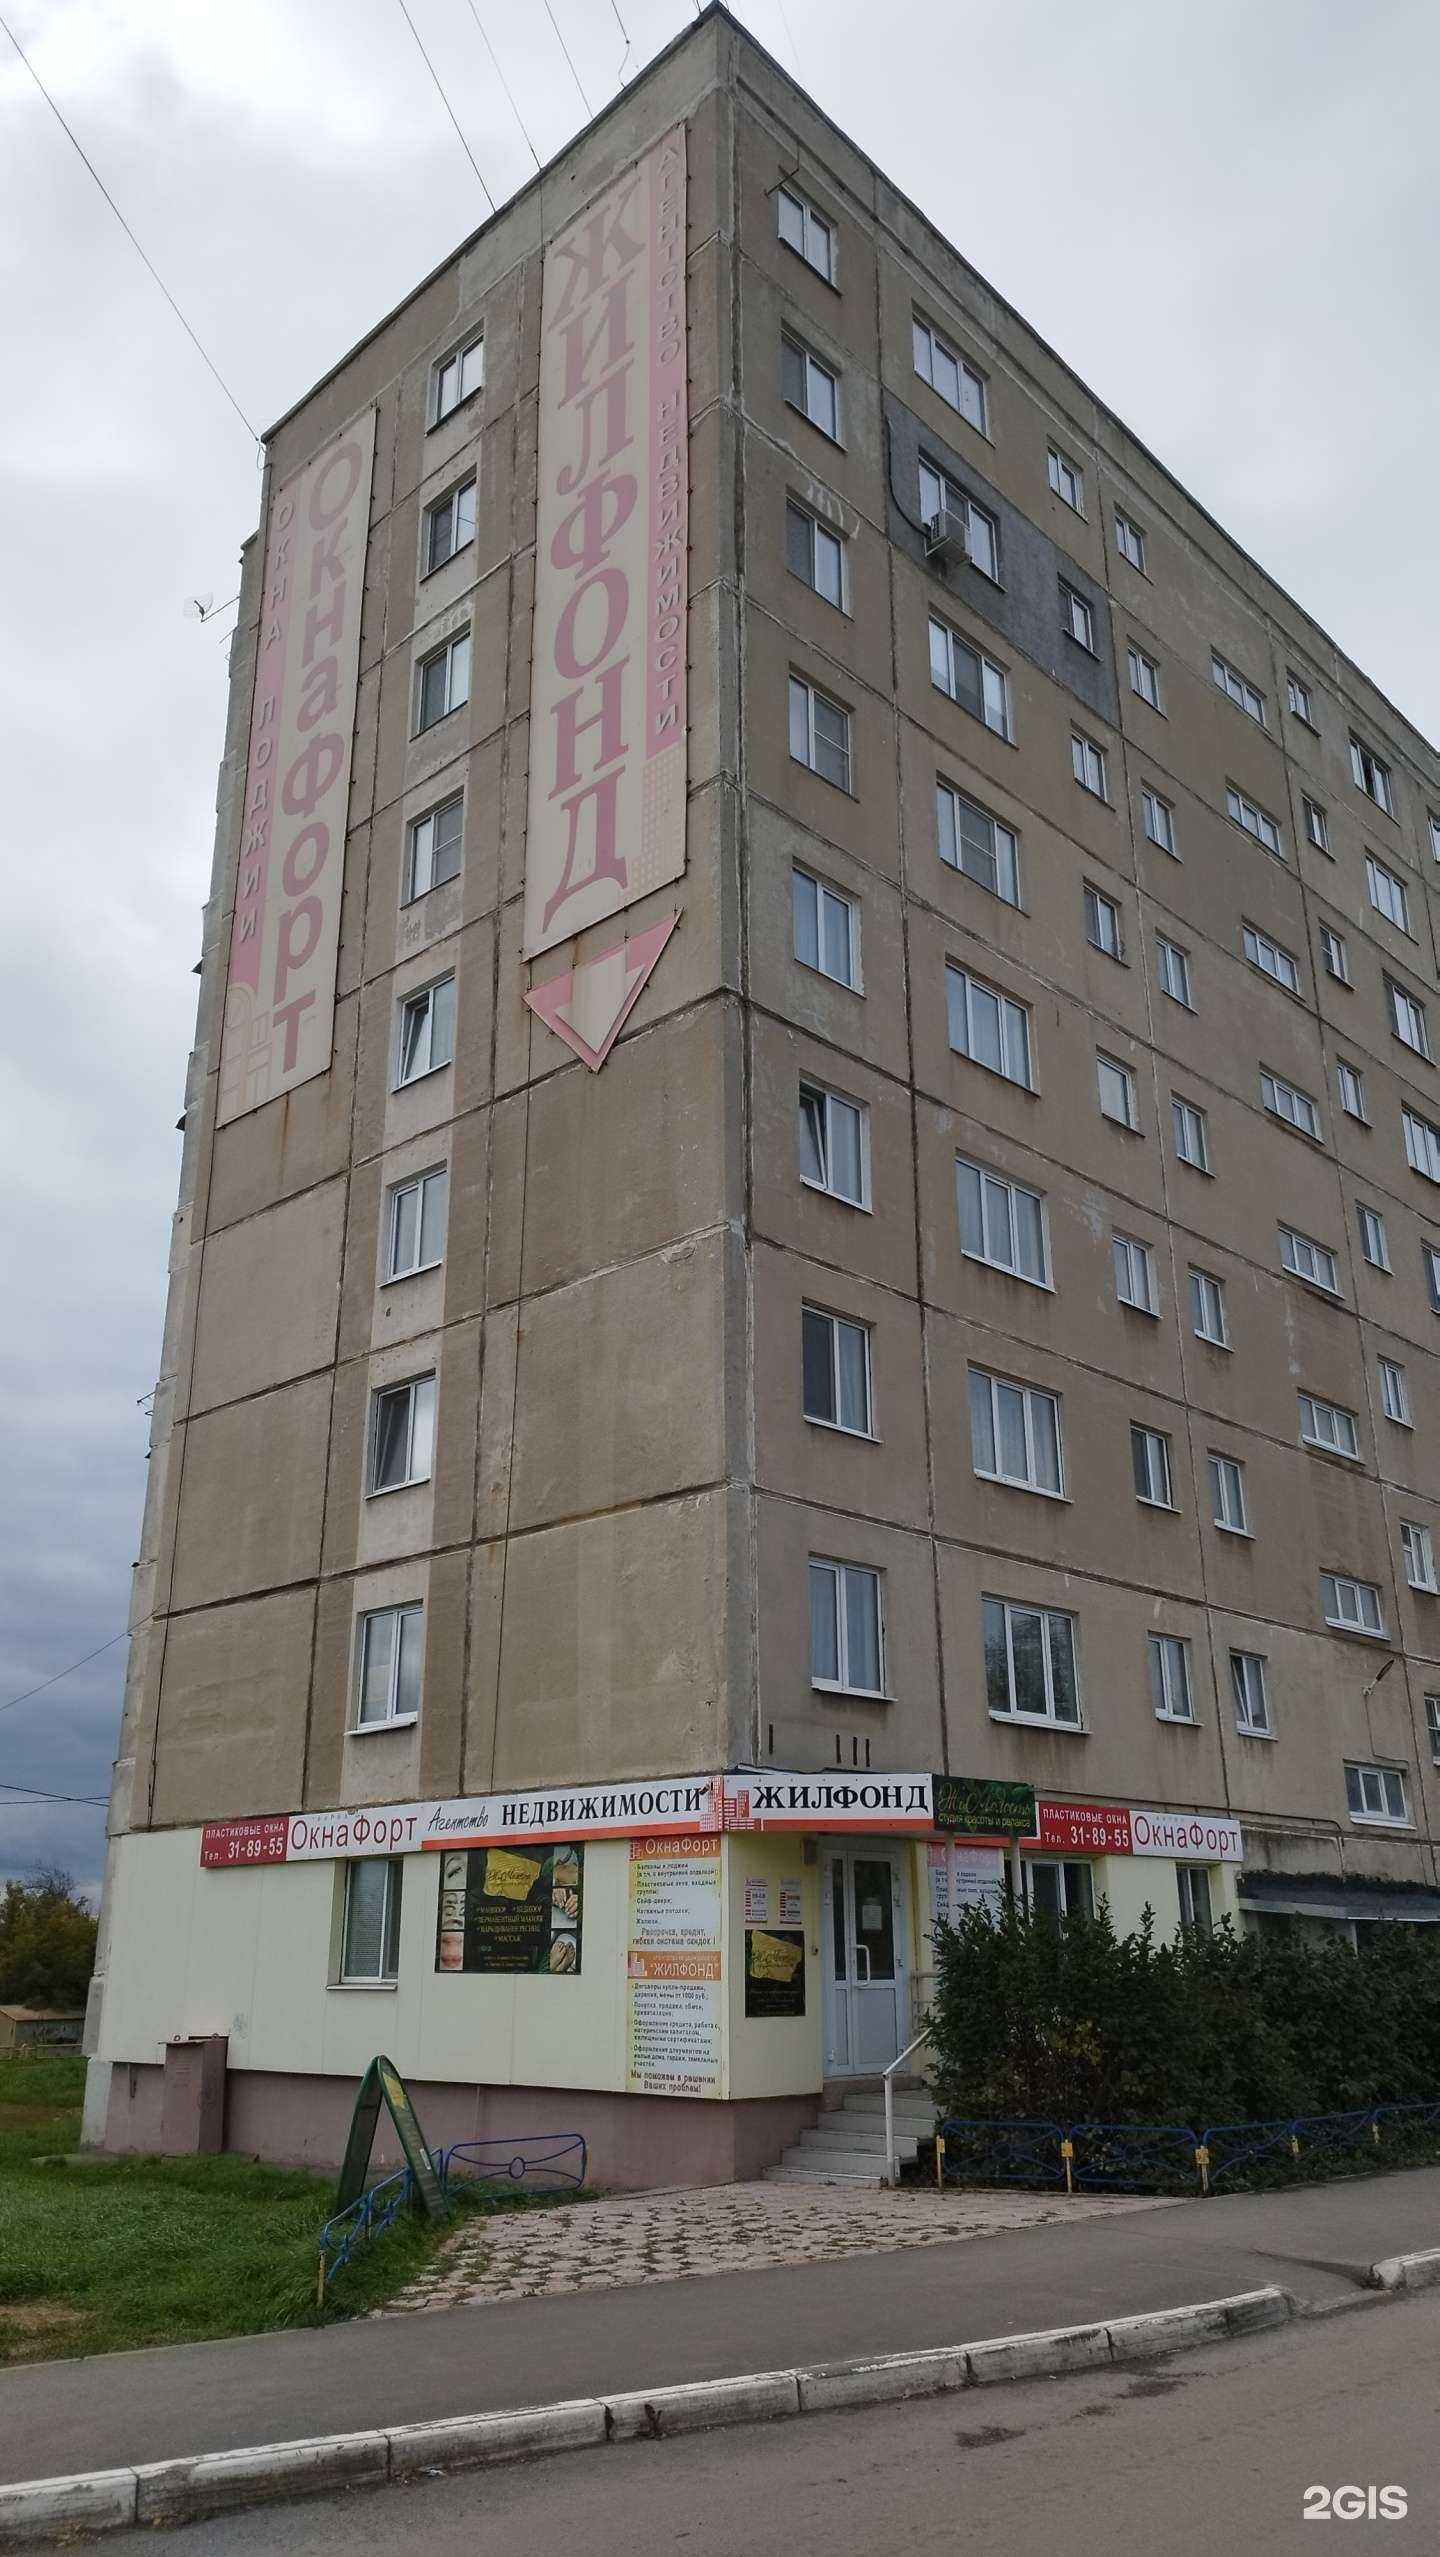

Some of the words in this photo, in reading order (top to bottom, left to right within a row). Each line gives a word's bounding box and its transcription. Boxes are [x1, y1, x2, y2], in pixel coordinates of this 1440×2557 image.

[542, 175, 646, 934] ЖИЛФОНД
[655, 391, 682, 736] НЕДВИЖИМОСТИ
[267, 501, 295, 650] ОКНА
[240, 695, 275, 943] ЛОДЖИИ
[428, 1806, 489, 1832] Агентство
[502, 1788, 701, 1827] НЕДВИЖИМОСТИ
[752, 1785, 929, 1813] ЖИЛФОНД
[205, 1825, 261, 1839] ПЛАСТИКОВЫЕ
[264, 1823, 285, 1832] ОКНА
[938, 1813, 963, 1824] студия
[964, 1815, 994, 1827] красоты
[1002, 1817, 1031, 1828] релакса
[1043, 1808, 1102, 1823] ПЛАСТИКОВЫЕ
[1106, 1814, 1127, 1825] ОКНА
[291, 1815, 418, 1850] ОкнаФорт
[645, 1838, 718, 1855] ОкнаФорт
[1070, 1826, 1129, 1848] 31-89-55
[1134, 1815, 1238, 1858] ОкнаФорт
[204, 1851, 222, 1861] Тел.
[228, 1837, 283, 1859] 31-89-55
